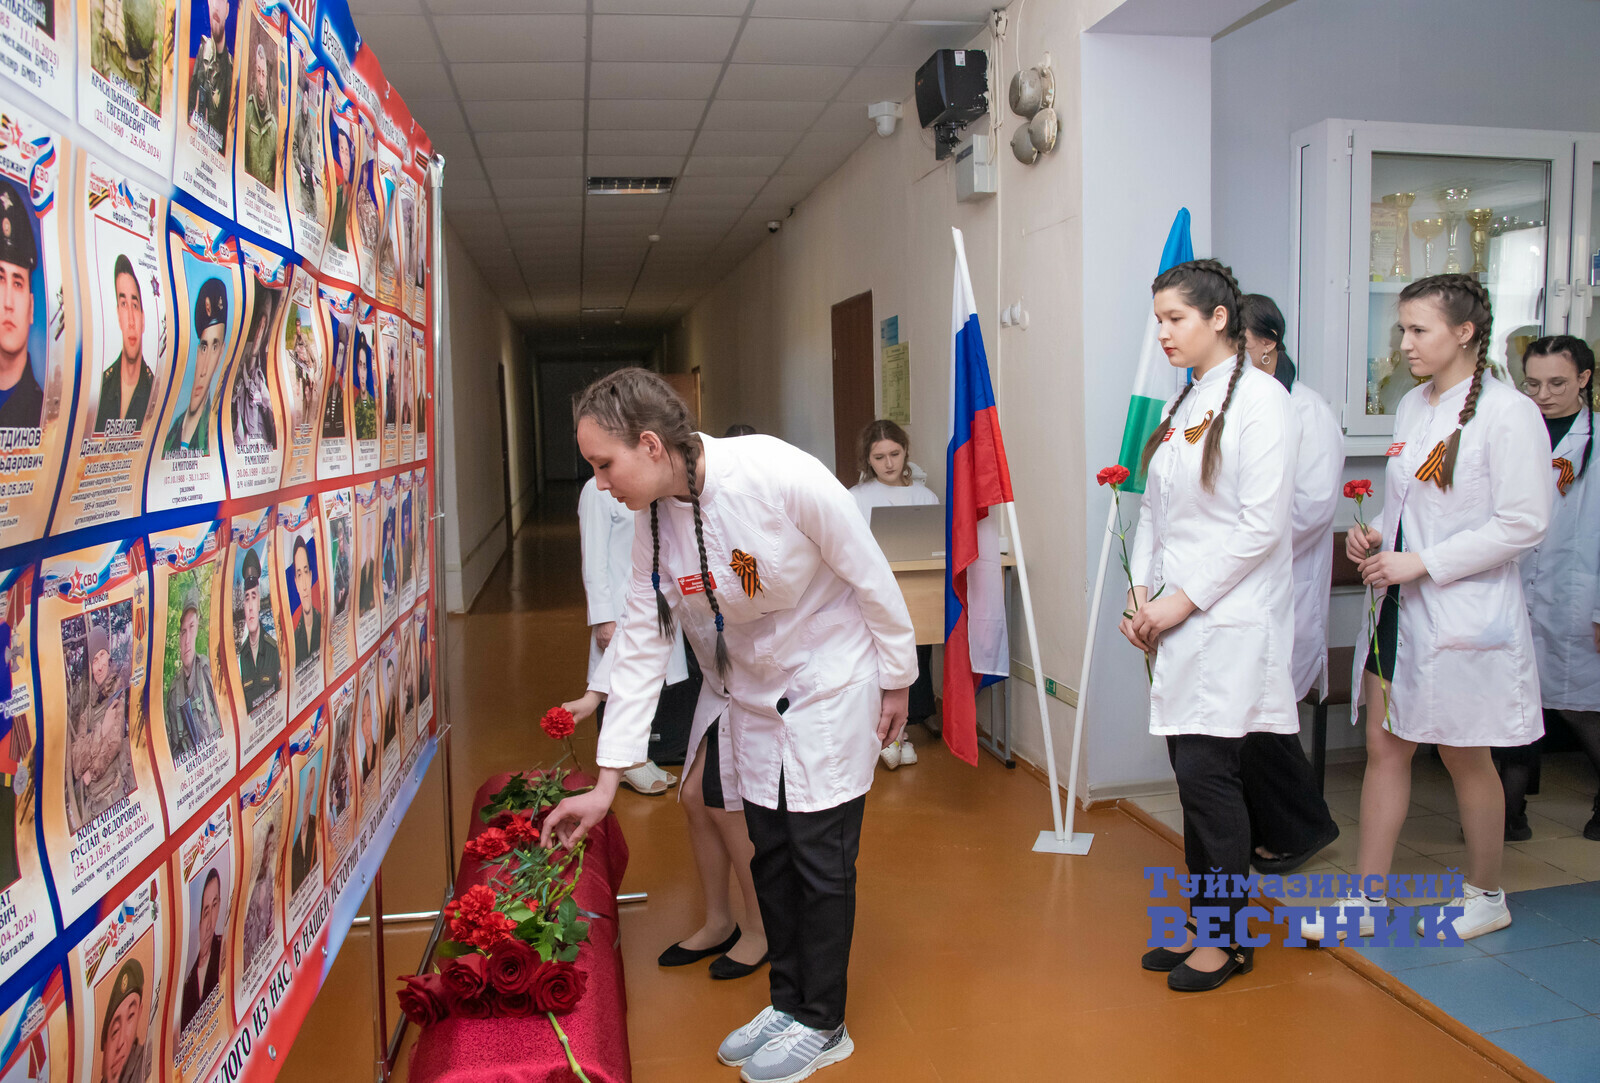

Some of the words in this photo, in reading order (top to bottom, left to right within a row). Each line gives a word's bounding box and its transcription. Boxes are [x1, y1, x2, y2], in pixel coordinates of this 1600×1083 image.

[91, 72, 140, 117] КРАСИЛЬНИКОВ
[141, 106, 162, 132] ДЕНИС
[106, 101, 146, 136] ЕВГЕНЬЕВИЧ
[35, 166, 49, 184] СВО
[105, 420, 136, 437] РЫБАКОВ
[102, 440, 144, 454] Александрович
[186, 547, 196, 559] СВО
[83, 572, 98, 587] СВО
[84, 592, 109, 609] рядовой
[70, 832, 100, 864] РУСЛАН
[102, 801, 142, 839] ФЕДОРОВИЧ
[77, 796, 130, 842] КОНСТАНТИНОВ
[72, 872, 96, 896] наводчик
[96, 840, 134, 874] мотострелкового
[134, 822, 154, 844] отделения
[74, 841, 110, 880] (25.12.1976
[116, 811, 150, 844] 28.08.2024)
[252, 997, 268, 1039] ИЗ
[269, 960, 293, 1011] НАС,
[294, 942, 301, 968] В
[302, 891, 330, 953] НАШЕЙ
[330, 842, 359, 905] ИСТОРИИ
[360, 830, 368, 855] НЕ
[368, 794, 388, 842] ДОЛЖНО
[0, 930, 34, 966] батальон
[86, 948, 100, 968] ПОЛК
[118, 922, 127, 936] СВО
[115, 932, 135, 961] рядовой
